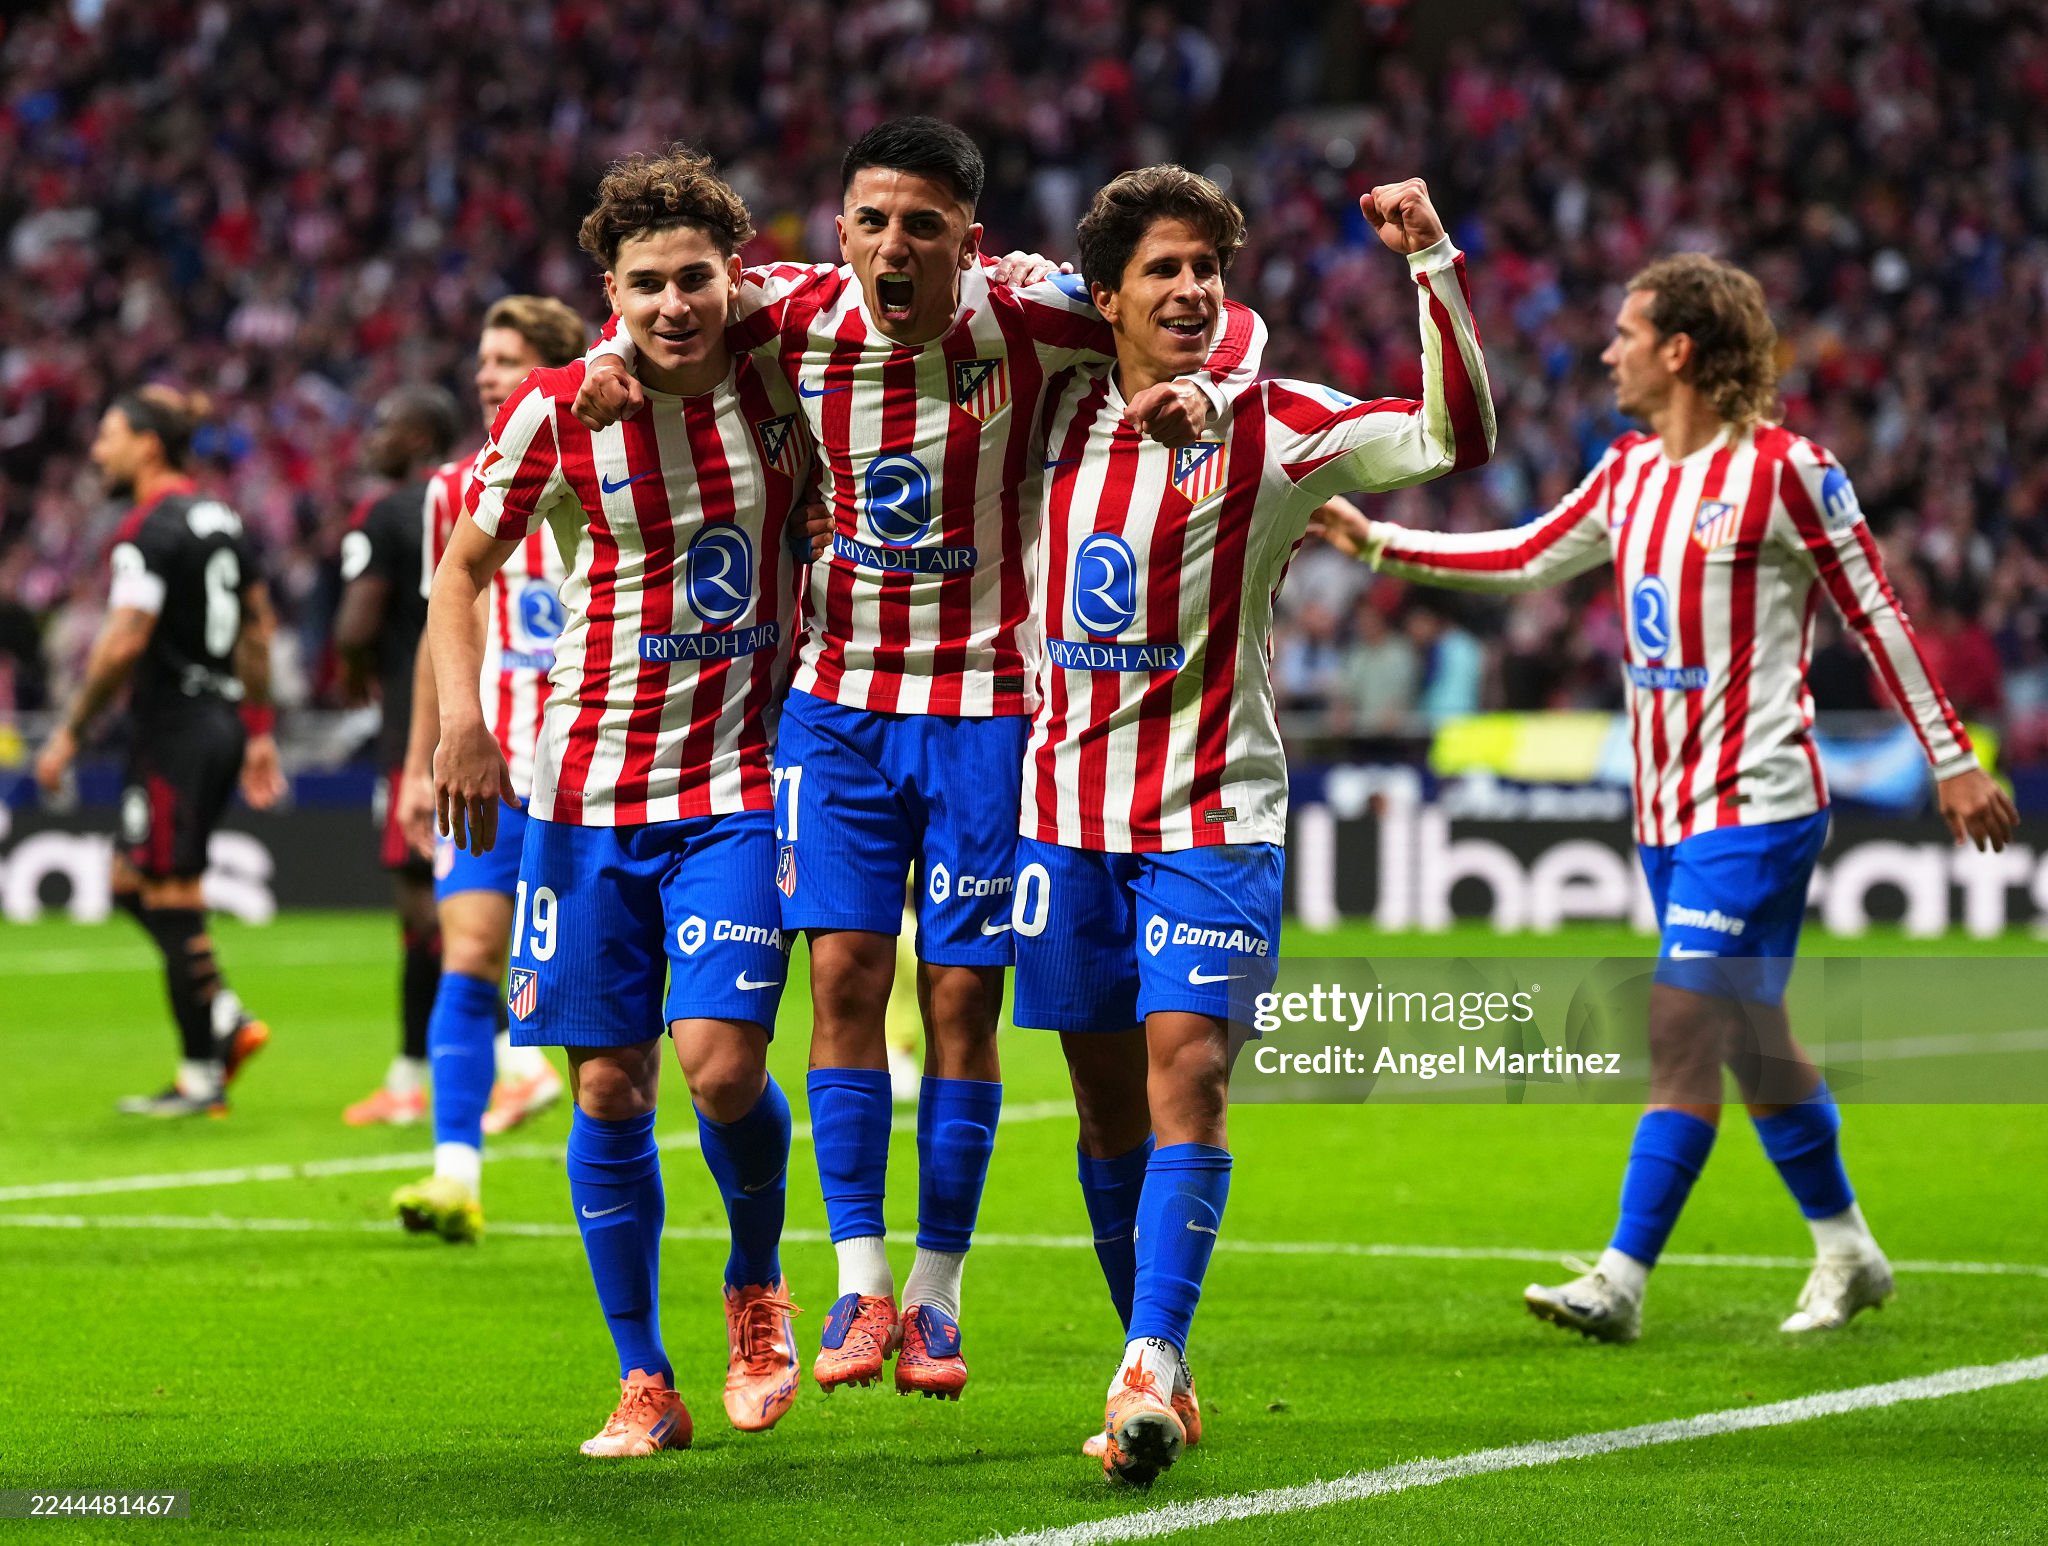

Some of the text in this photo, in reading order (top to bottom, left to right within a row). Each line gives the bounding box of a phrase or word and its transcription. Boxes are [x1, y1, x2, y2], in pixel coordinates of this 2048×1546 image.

[838, 535, 972, 570] RIYADH AIR
[205, 547, 241, 658] 6
[645, 624, 775, 659] RIYADH AIR
[1050, 641, 1179, 669] RIYADH AIR
[958, 875, 1013, 897] Com
[511, 880, 558, 962] 19
[1172, 923, 1269, 957] ComAve
